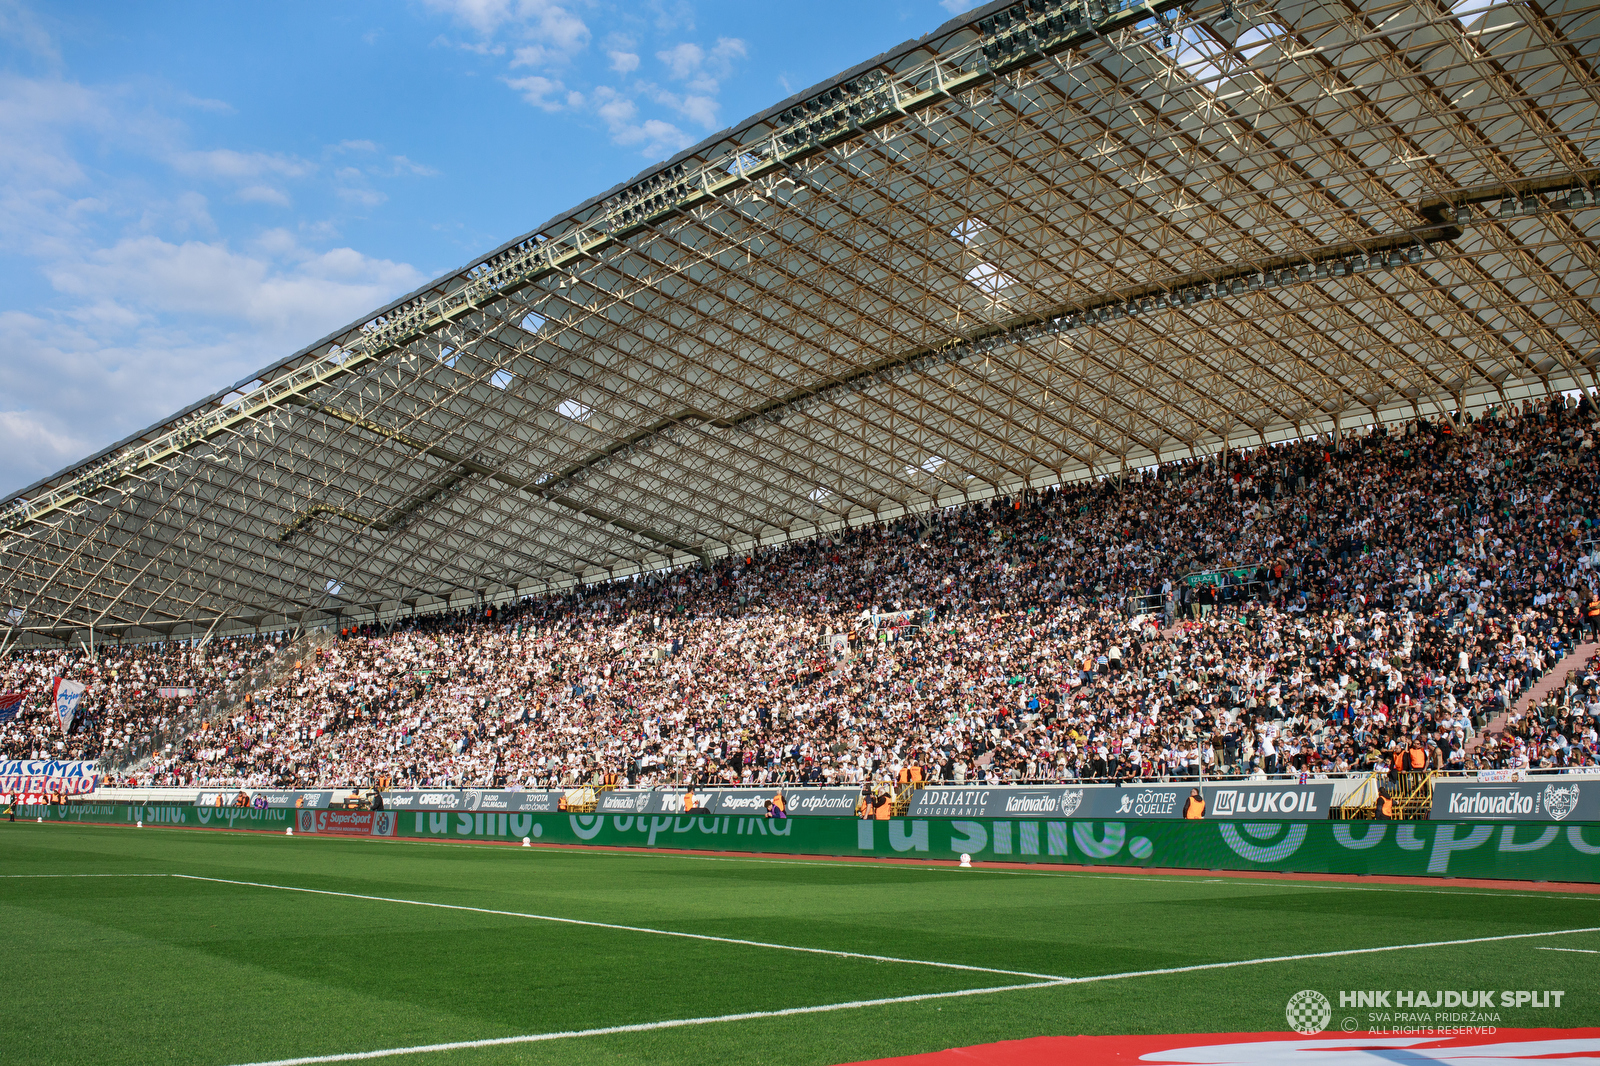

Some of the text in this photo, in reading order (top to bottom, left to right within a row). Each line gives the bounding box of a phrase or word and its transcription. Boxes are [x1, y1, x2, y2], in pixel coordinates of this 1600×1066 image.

[419, 793, 456, 805] ORBICO
[526, 794, 549, 802] TOYOTA
[801, 794, 853, 811] otpbanka
[919, 791, 990, 806] ADRIATIC
[1005, 795, 1056, 812] Karlovačko
[1236, 791, 1317, 813] LUKOIL
[1449, 792, 1533, 814] Karlovačko
[519, 803, 532, 811] AUTO
[916, 807, 986, 817] OSIGURANJE
[1134, 803, 1174, 817] QUELLE
[329, 812, 371, 825] SuperSport
